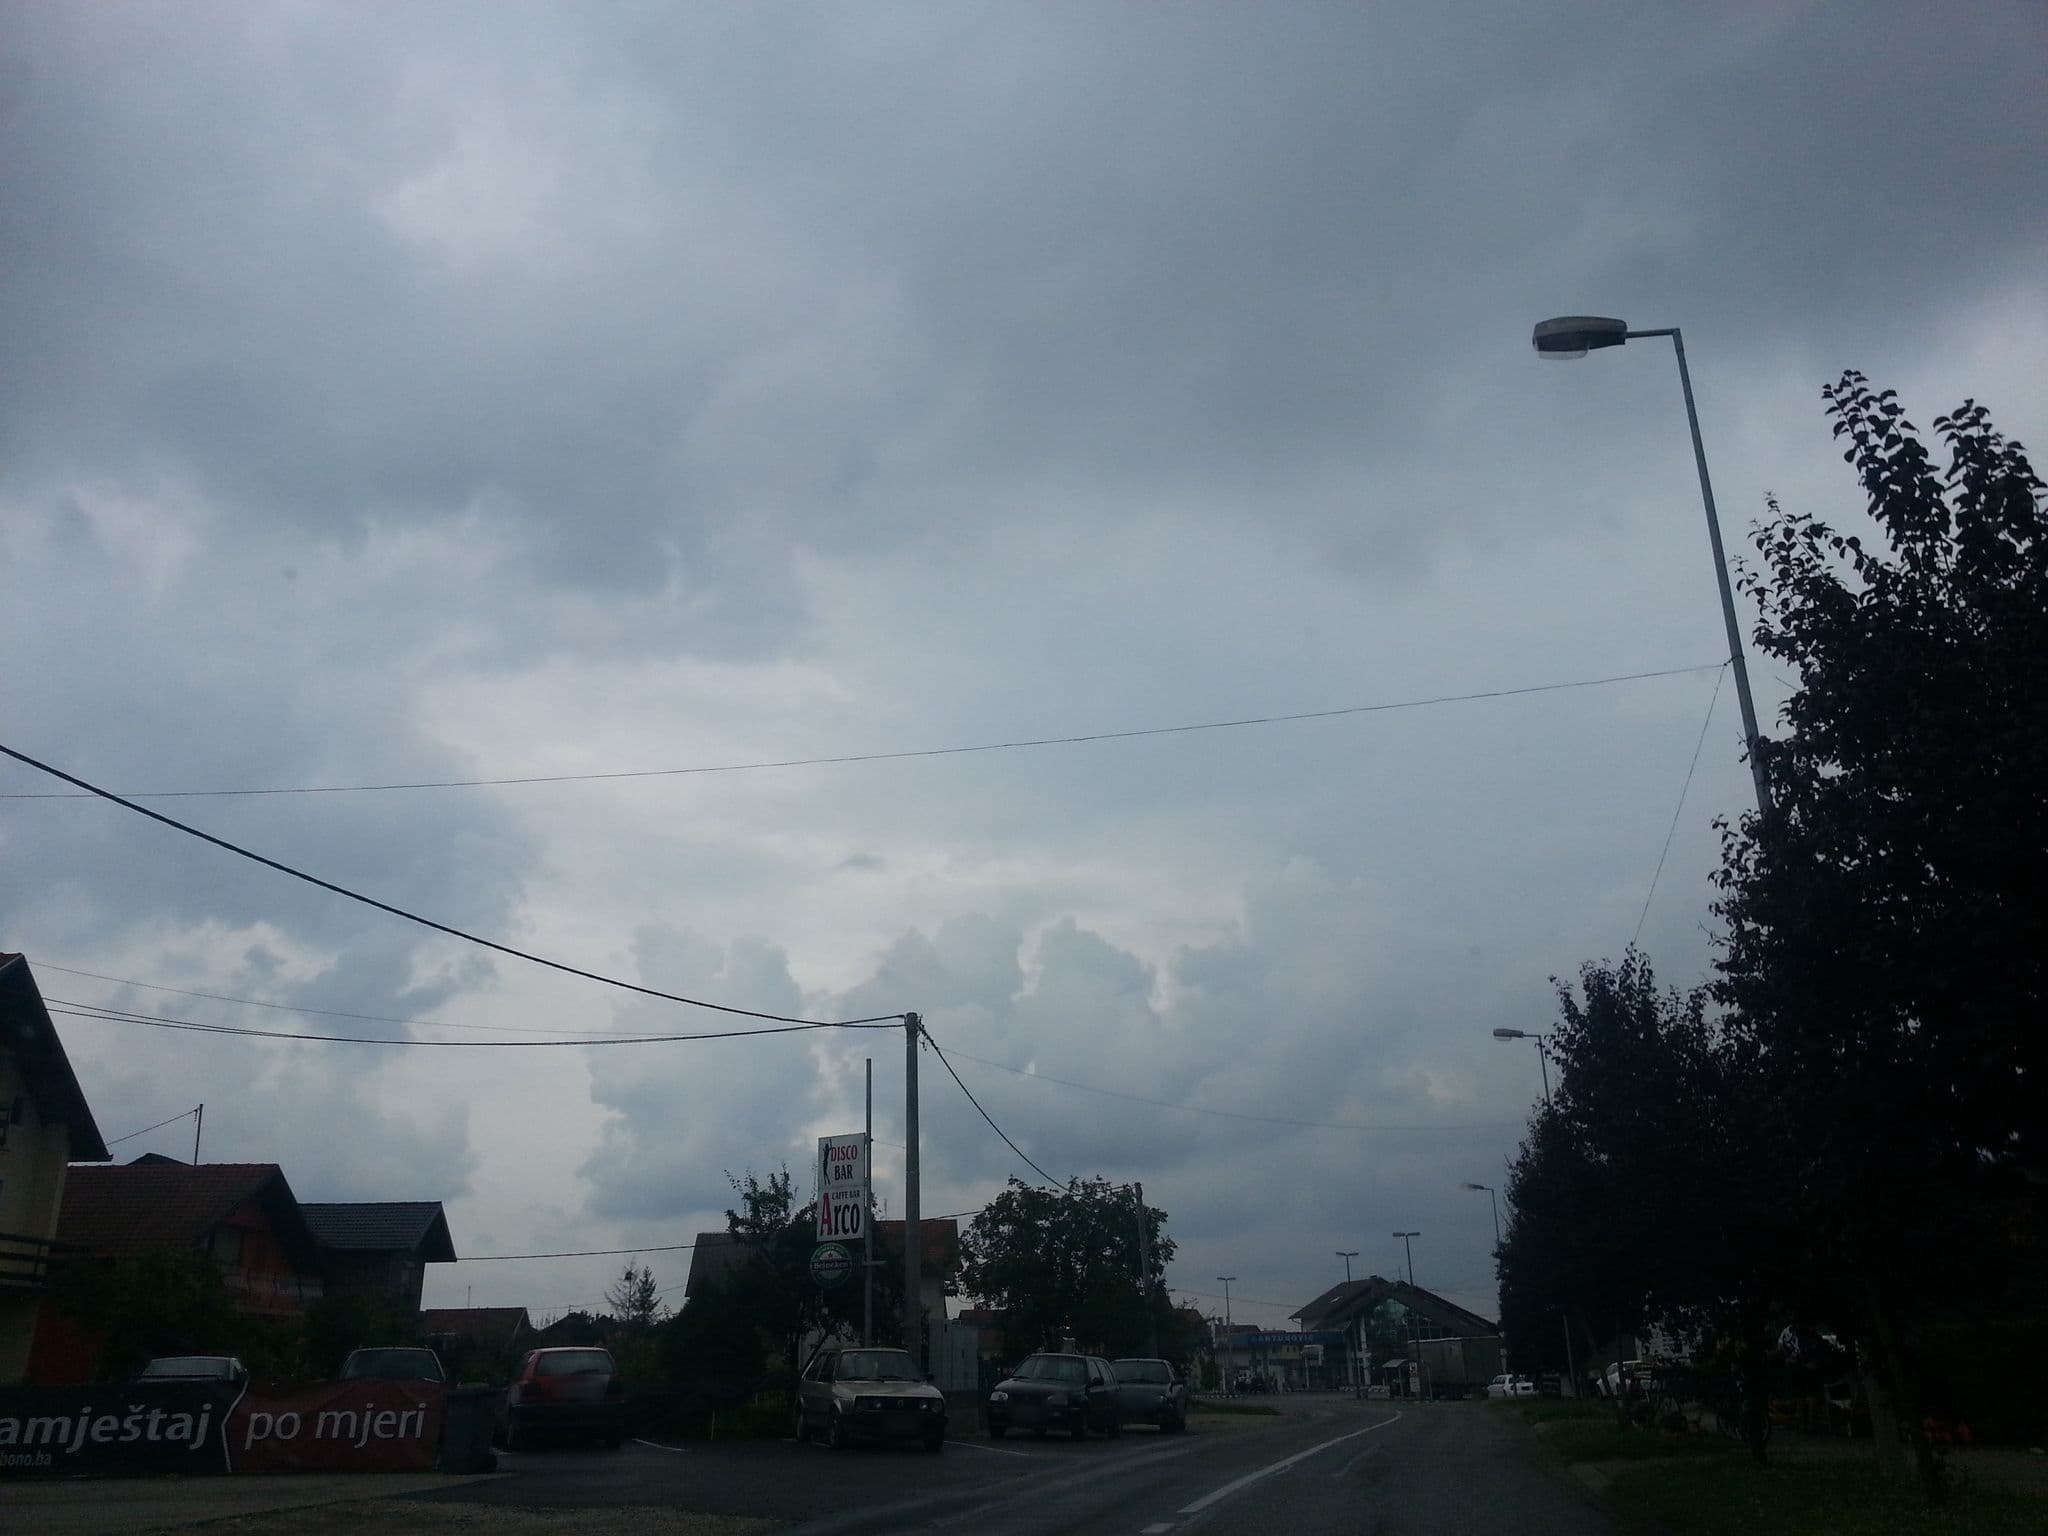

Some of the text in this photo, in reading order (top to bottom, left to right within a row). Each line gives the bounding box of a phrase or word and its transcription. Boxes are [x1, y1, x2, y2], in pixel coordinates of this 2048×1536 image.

[831, 1145, 858, 1161] DISCO
[834, 1165, 853, 1180] BAR
[0, 1403, 427, 1454] amještaj po mjeri
